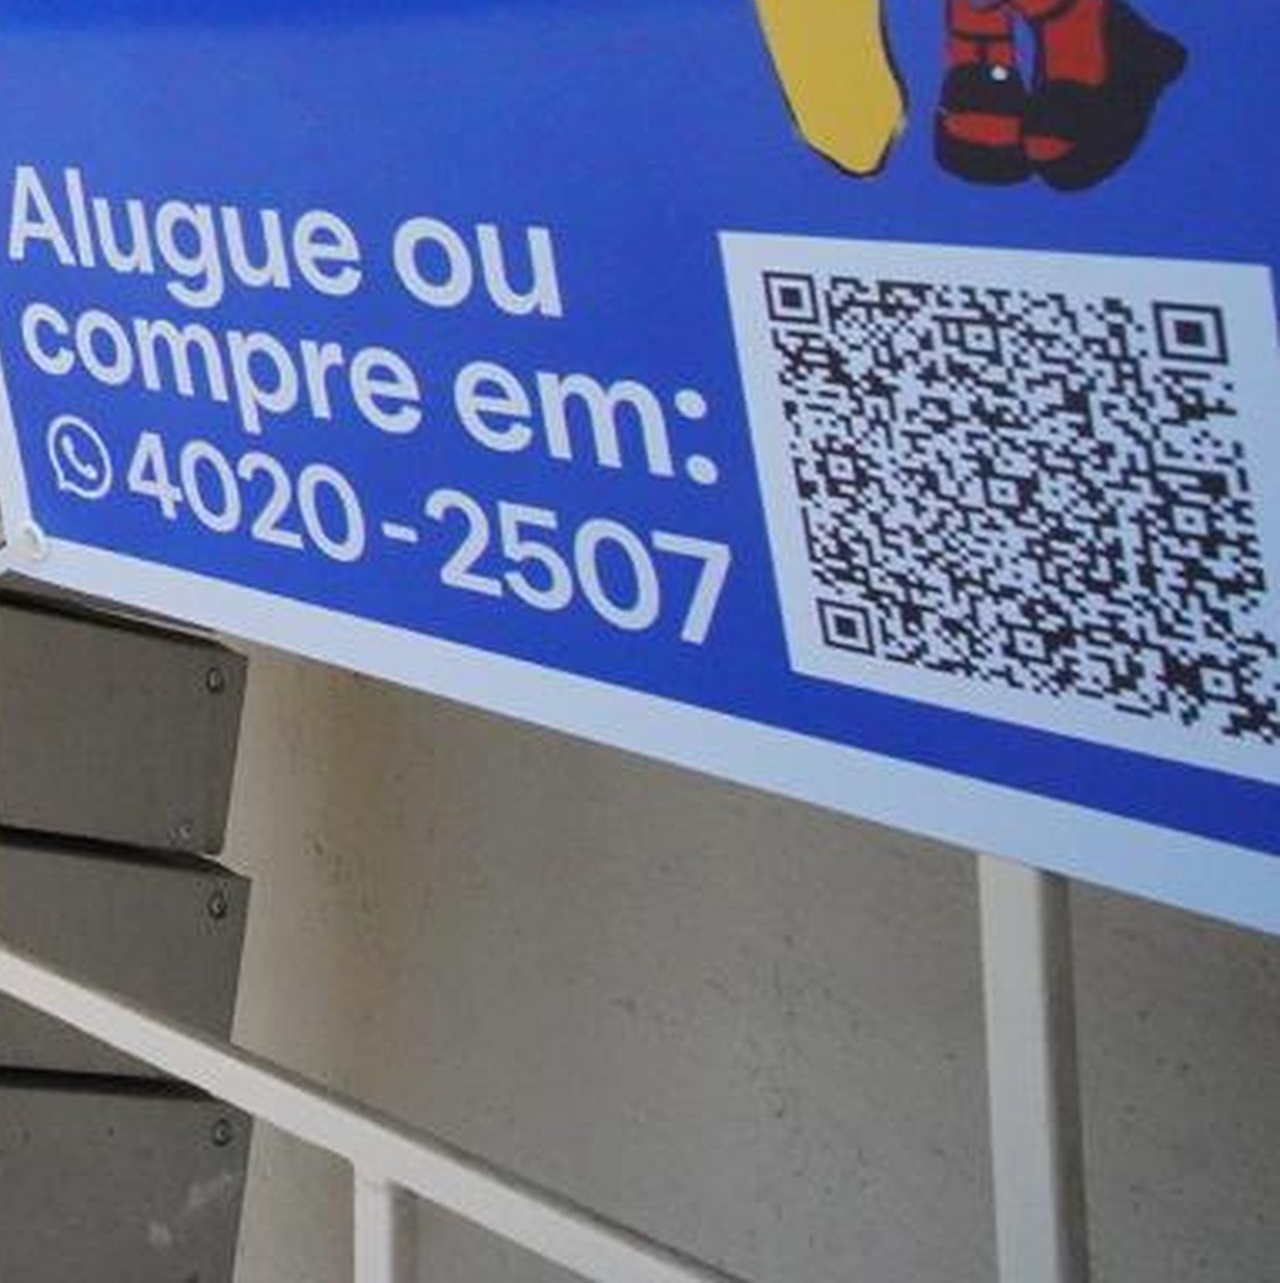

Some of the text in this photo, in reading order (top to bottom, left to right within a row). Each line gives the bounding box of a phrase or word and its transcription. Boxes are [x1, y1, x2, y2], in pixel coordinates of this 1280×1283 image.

[8, 165, 562, 317] Alugue ou
[21, 301, 720, 486] compre em:
[127, 432, 731, 646] 4020-2507
